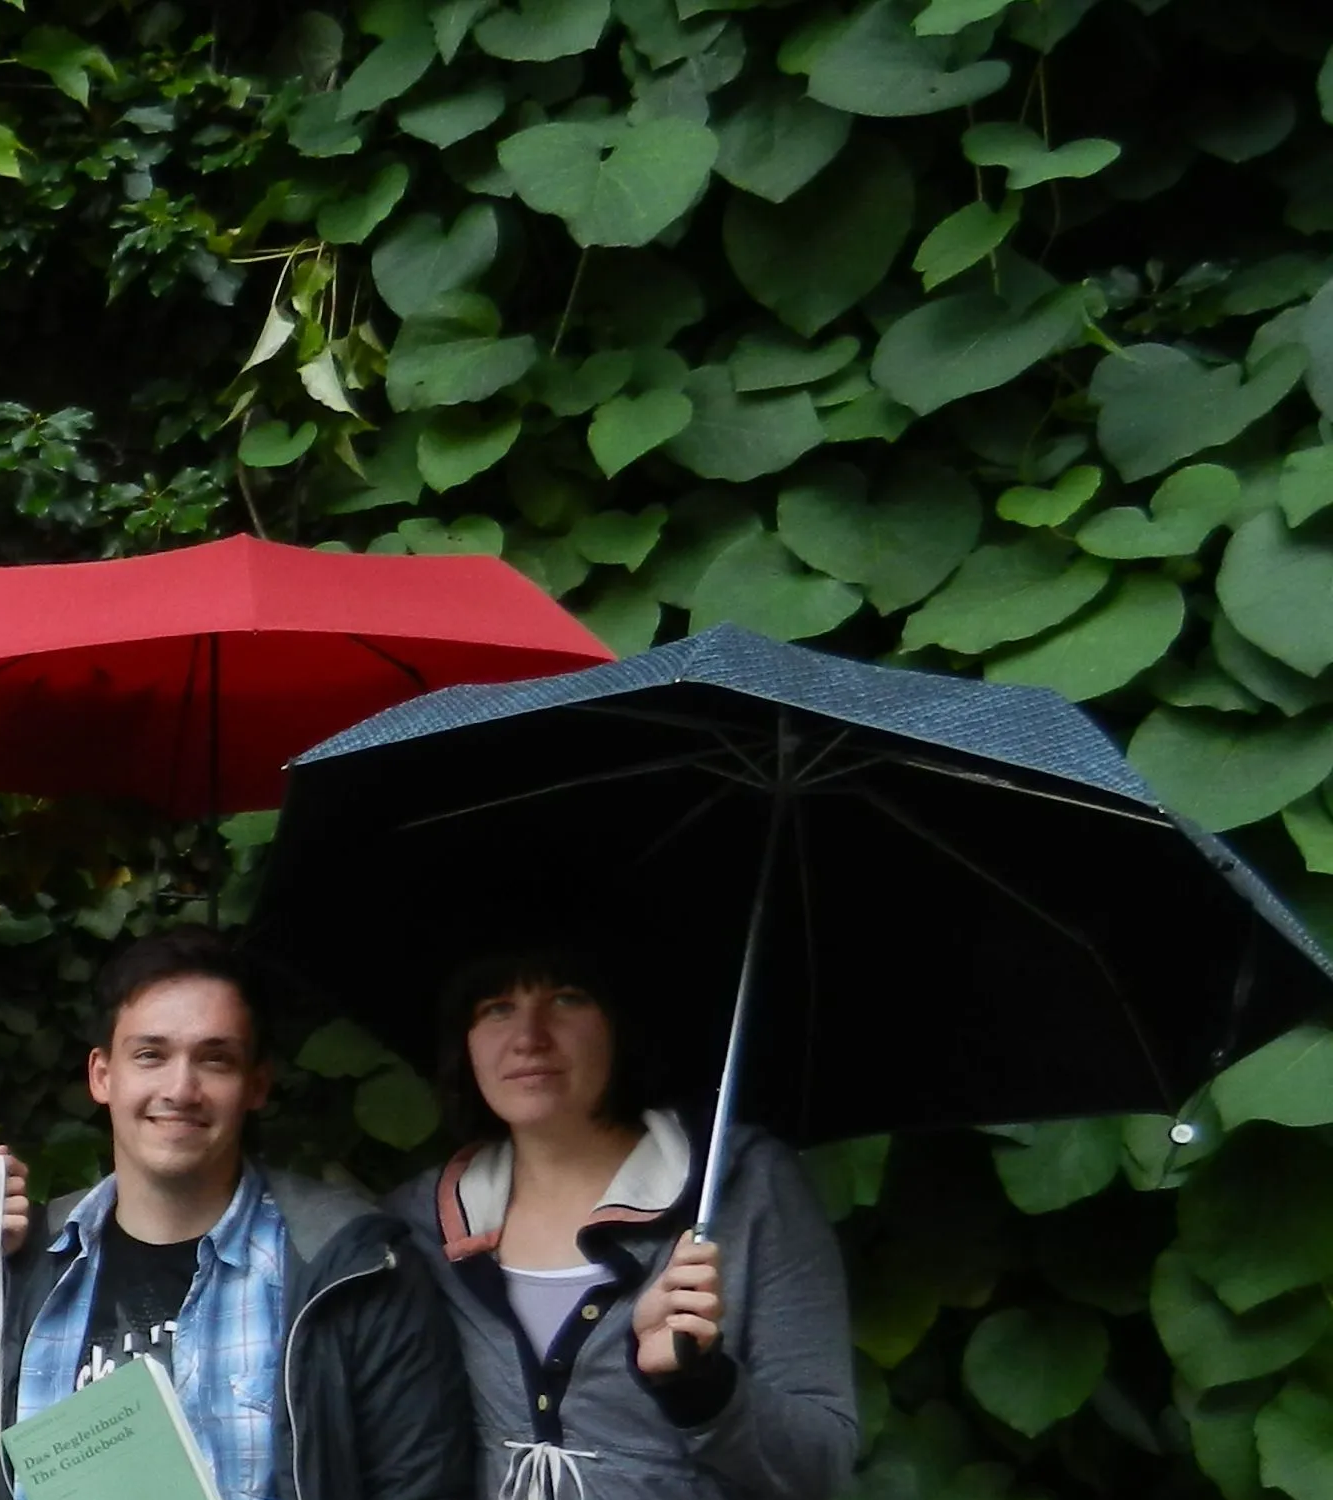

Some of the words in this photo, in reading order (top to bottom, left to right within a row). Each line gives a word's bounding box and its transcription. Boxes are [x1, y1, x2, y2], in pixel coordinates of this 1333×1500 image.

[23, 1450, 51, 1471] Das
[52, 1404, 136, 1456] Begleitbuch
[31, 1466, 59, 1486] The
[59, 1425, 136, 1471] Guidebook
